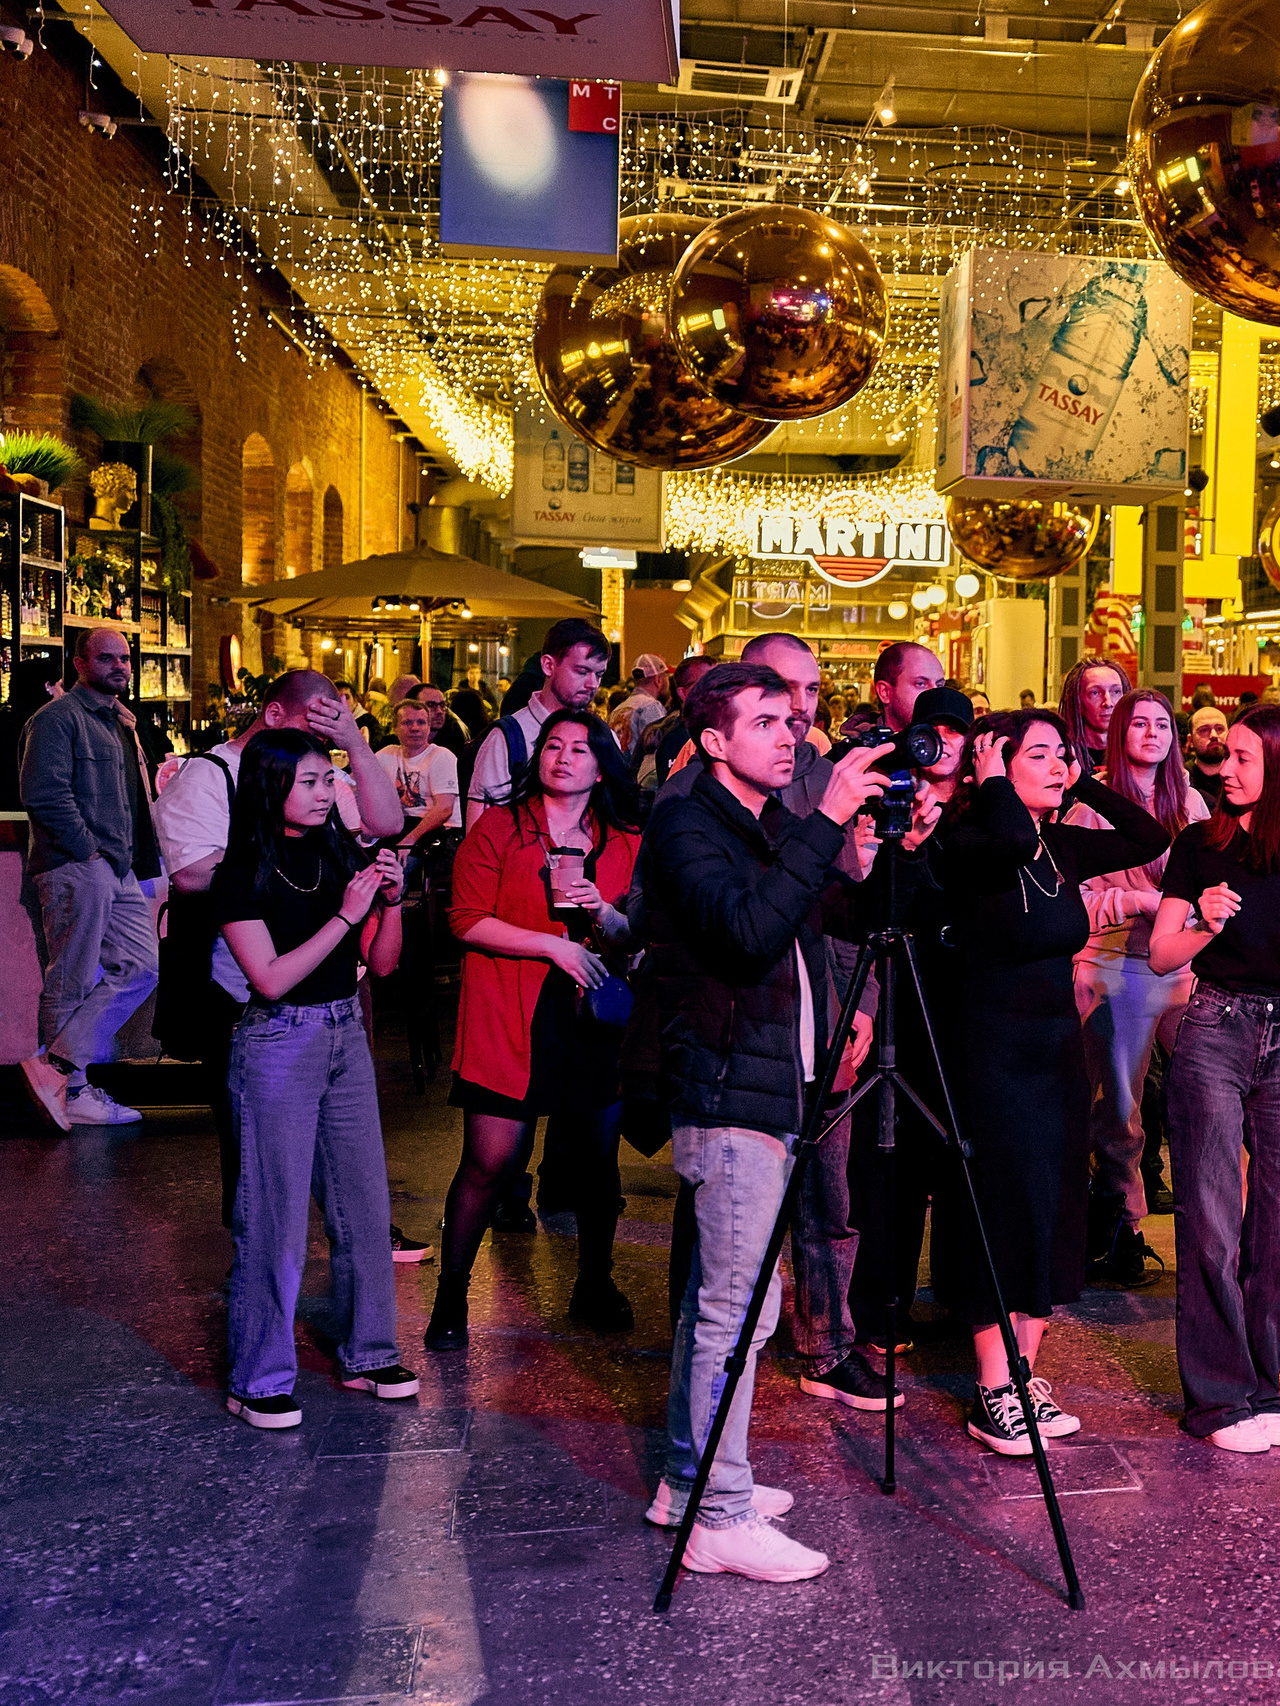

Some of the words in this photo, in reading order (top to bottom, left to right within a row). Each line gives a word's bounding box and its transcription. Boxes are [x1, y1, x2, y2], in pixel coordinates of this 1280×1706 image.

[1037, 382, 1105, 427] TASSAY
[533, 510, 577, 523] TASSAY
[761, 516, 942, 561] MARTINI
